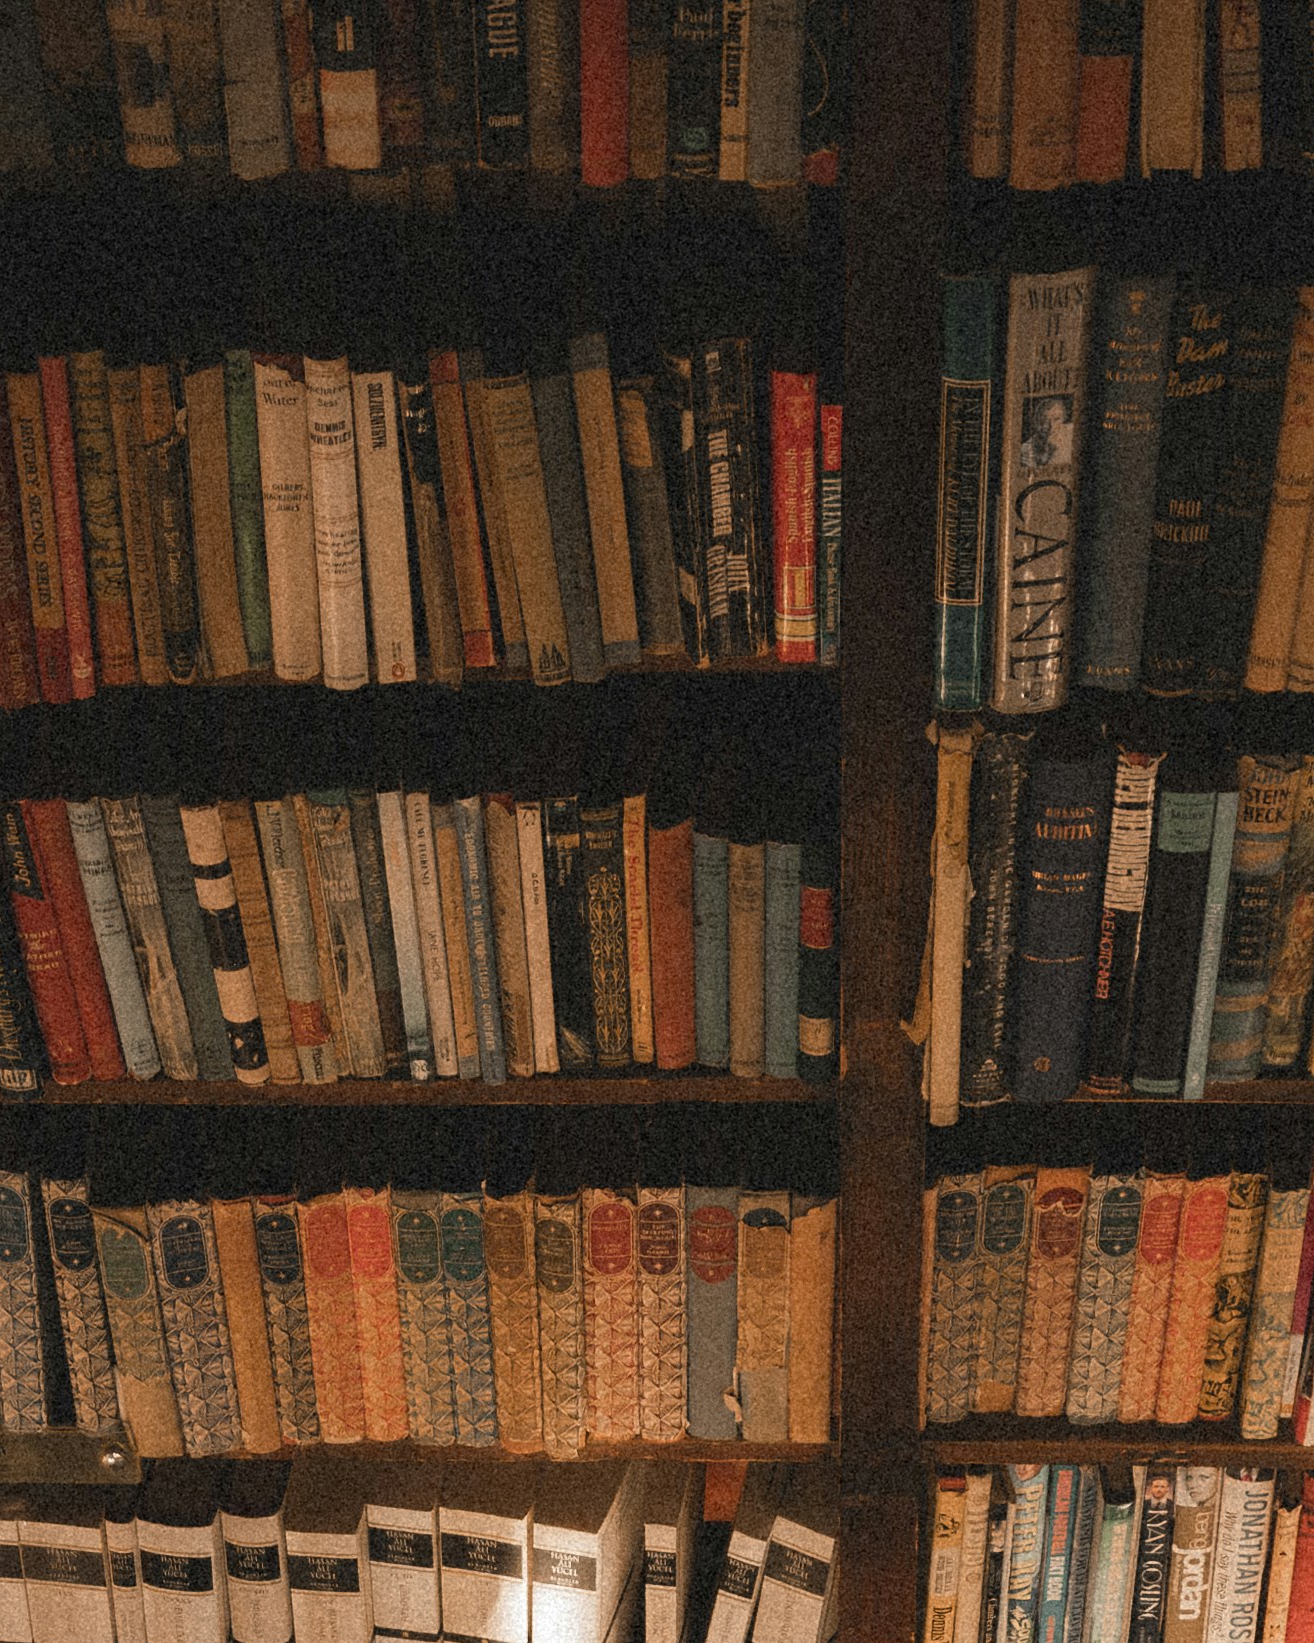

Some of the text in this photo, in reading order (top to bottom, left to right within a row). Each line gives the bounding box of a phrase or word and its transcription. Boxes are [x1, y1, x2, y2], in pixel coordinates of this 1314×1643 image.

[1005, 478, 1078, 690] CAINE
[1241, 805, 1284, 826] BECK
[1244, 784, 1289, 806] STEIN
[8, 846, 34, 890] John
[1233, 1489, 1270, 1597] JONATHAN
[1165, 1544, 1209, 1624] Jordan
